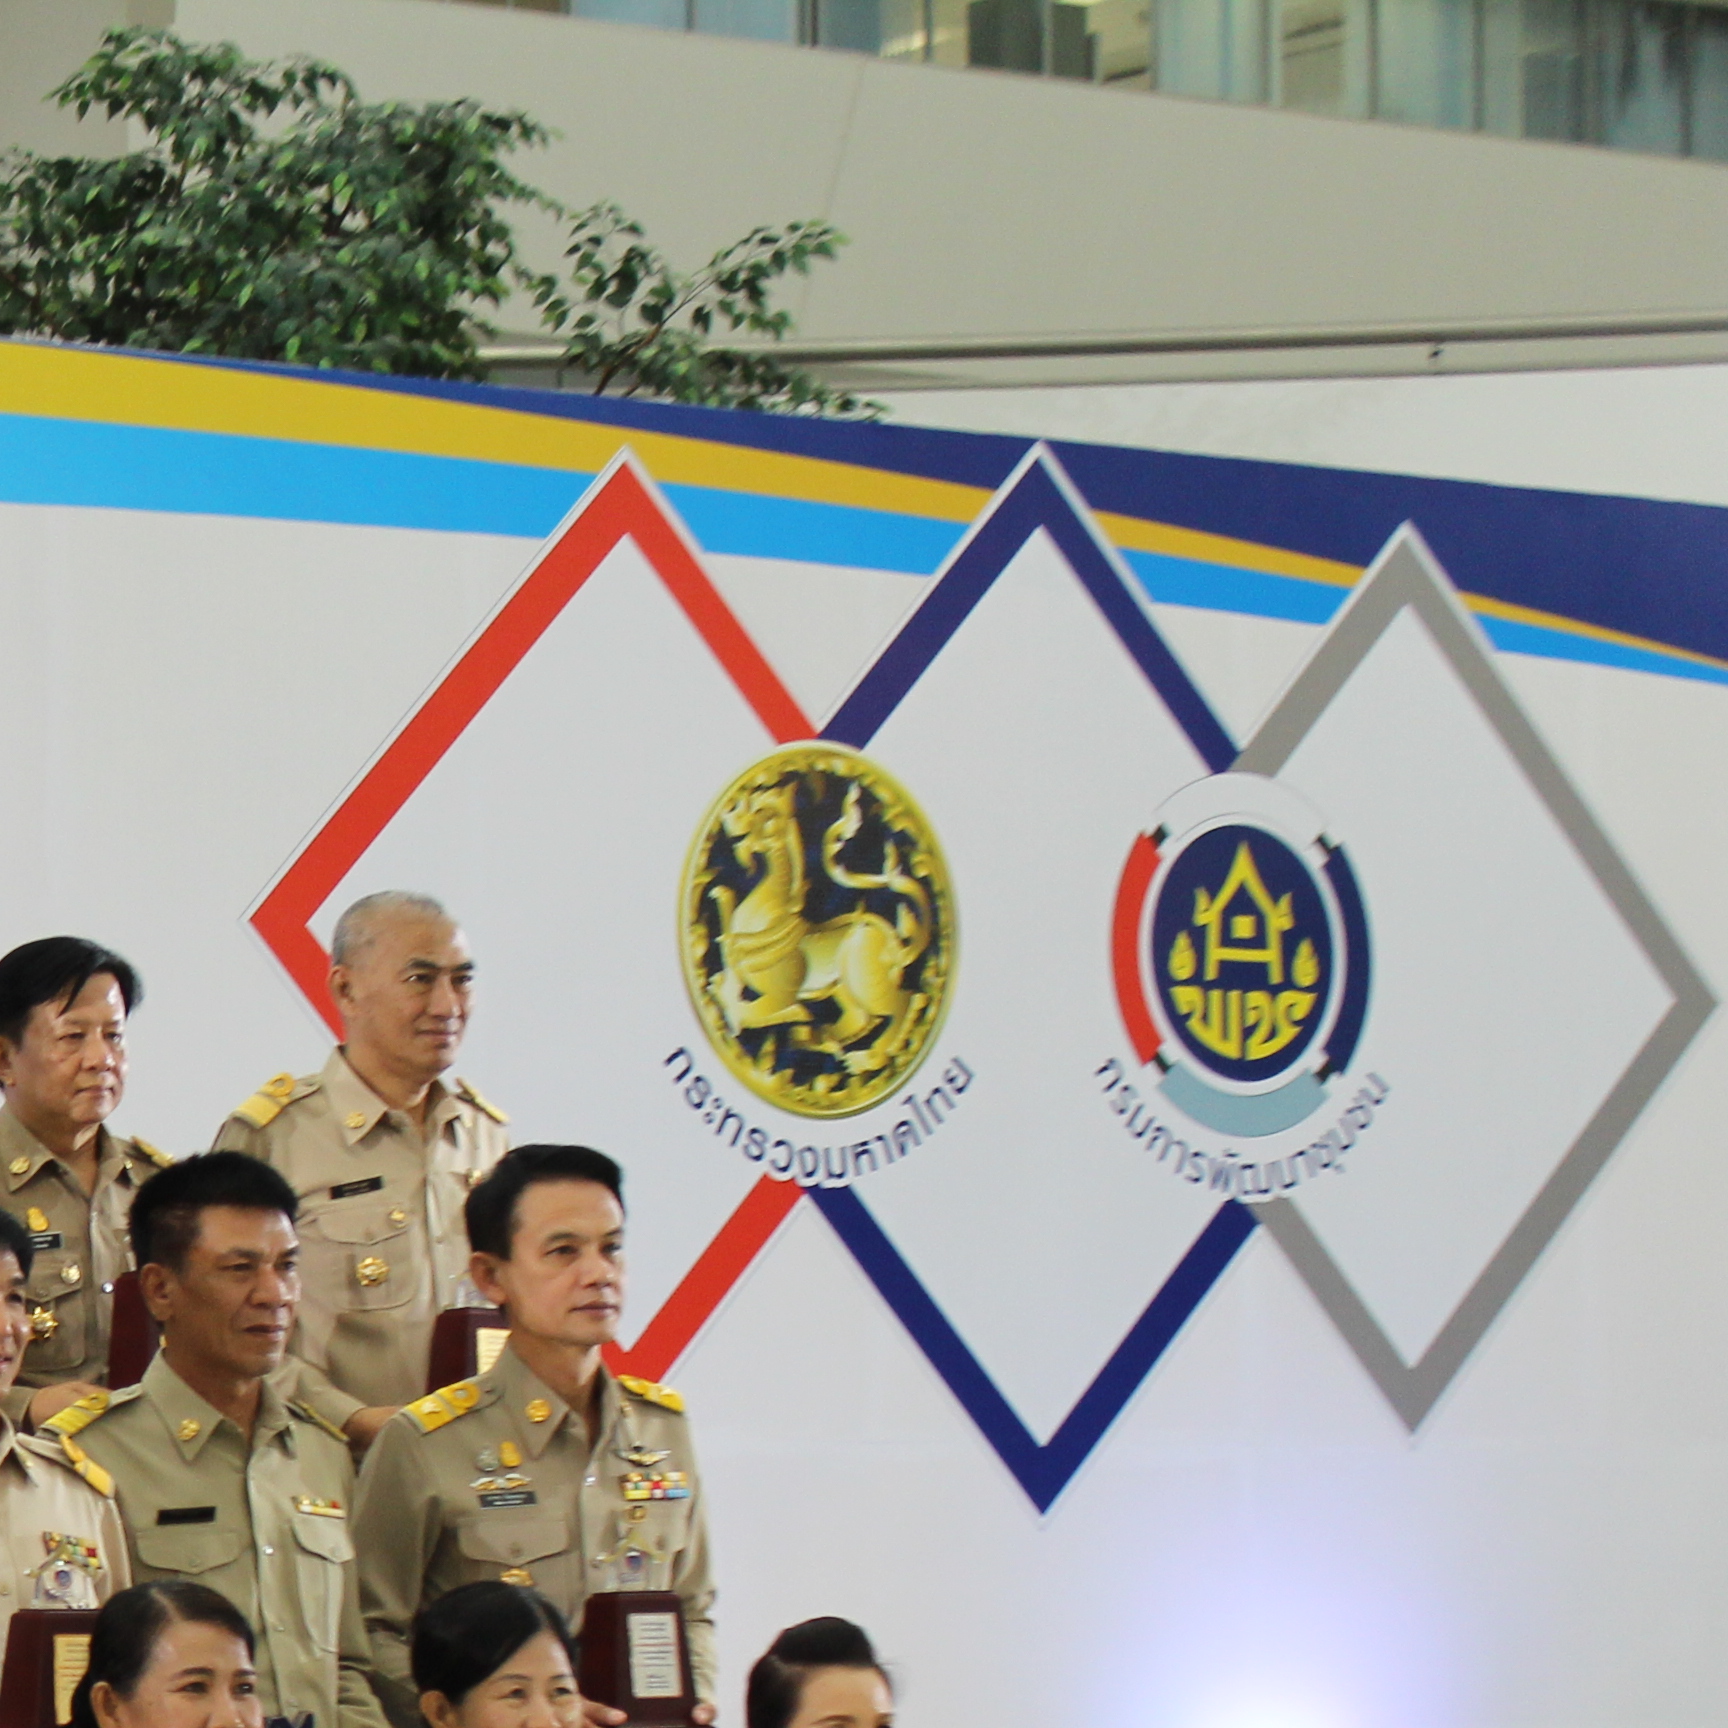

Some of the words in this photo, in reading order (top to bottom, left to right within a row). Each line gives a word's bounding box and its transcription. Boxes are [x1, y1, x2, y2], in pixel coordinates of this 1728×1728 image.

[662, 1046, 976, 1180] กระทรวงมหาดไทย
